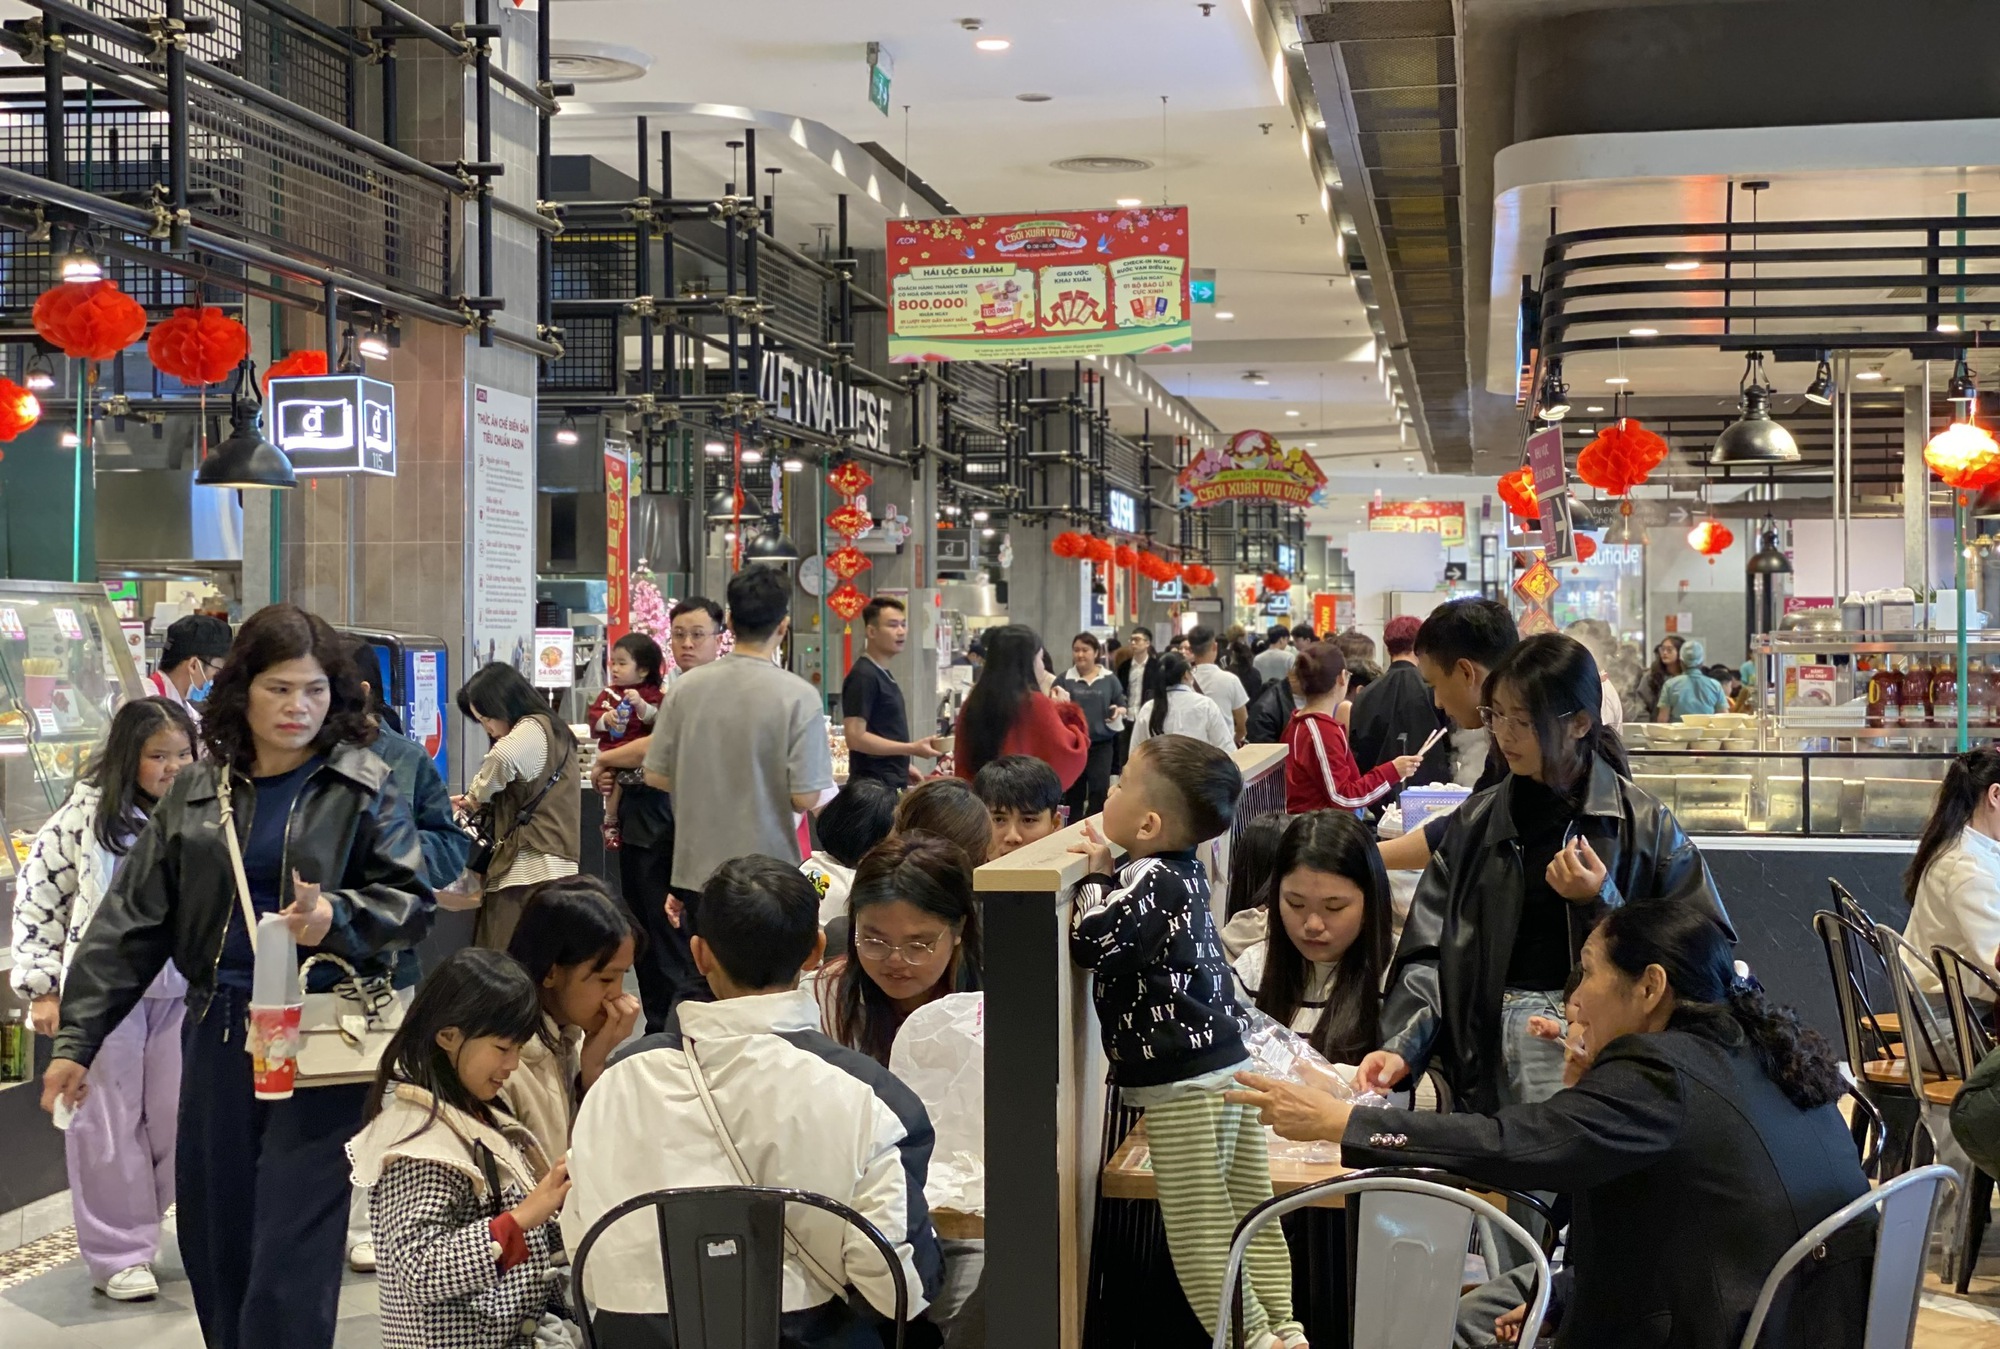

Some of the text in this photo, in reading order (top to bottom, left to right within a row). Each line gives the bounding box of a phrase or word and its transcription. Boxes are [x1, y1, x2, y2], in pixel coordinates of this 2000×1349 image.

[924, 268, 939, 276] HÁI
[942, 266, 959, 276] LỘC
[898, 298, 964, 311] 800,000
[478, 412, 490, 426] THỨC
[372, 452, 383, 470] 115
[1262, 481, 1281, 496] VUI
[1183, 878, 1200, 894] NY
[1138, 892, 1156, 915] NY
[1168, 912, 1192, 932] NY
[1099, 932, 1121, 957] NY
[1170, 972, 1192, 990] NY
[1151, 1003, 1175, 1022] NY
[1189, 1030, 1213, 1049] NY
